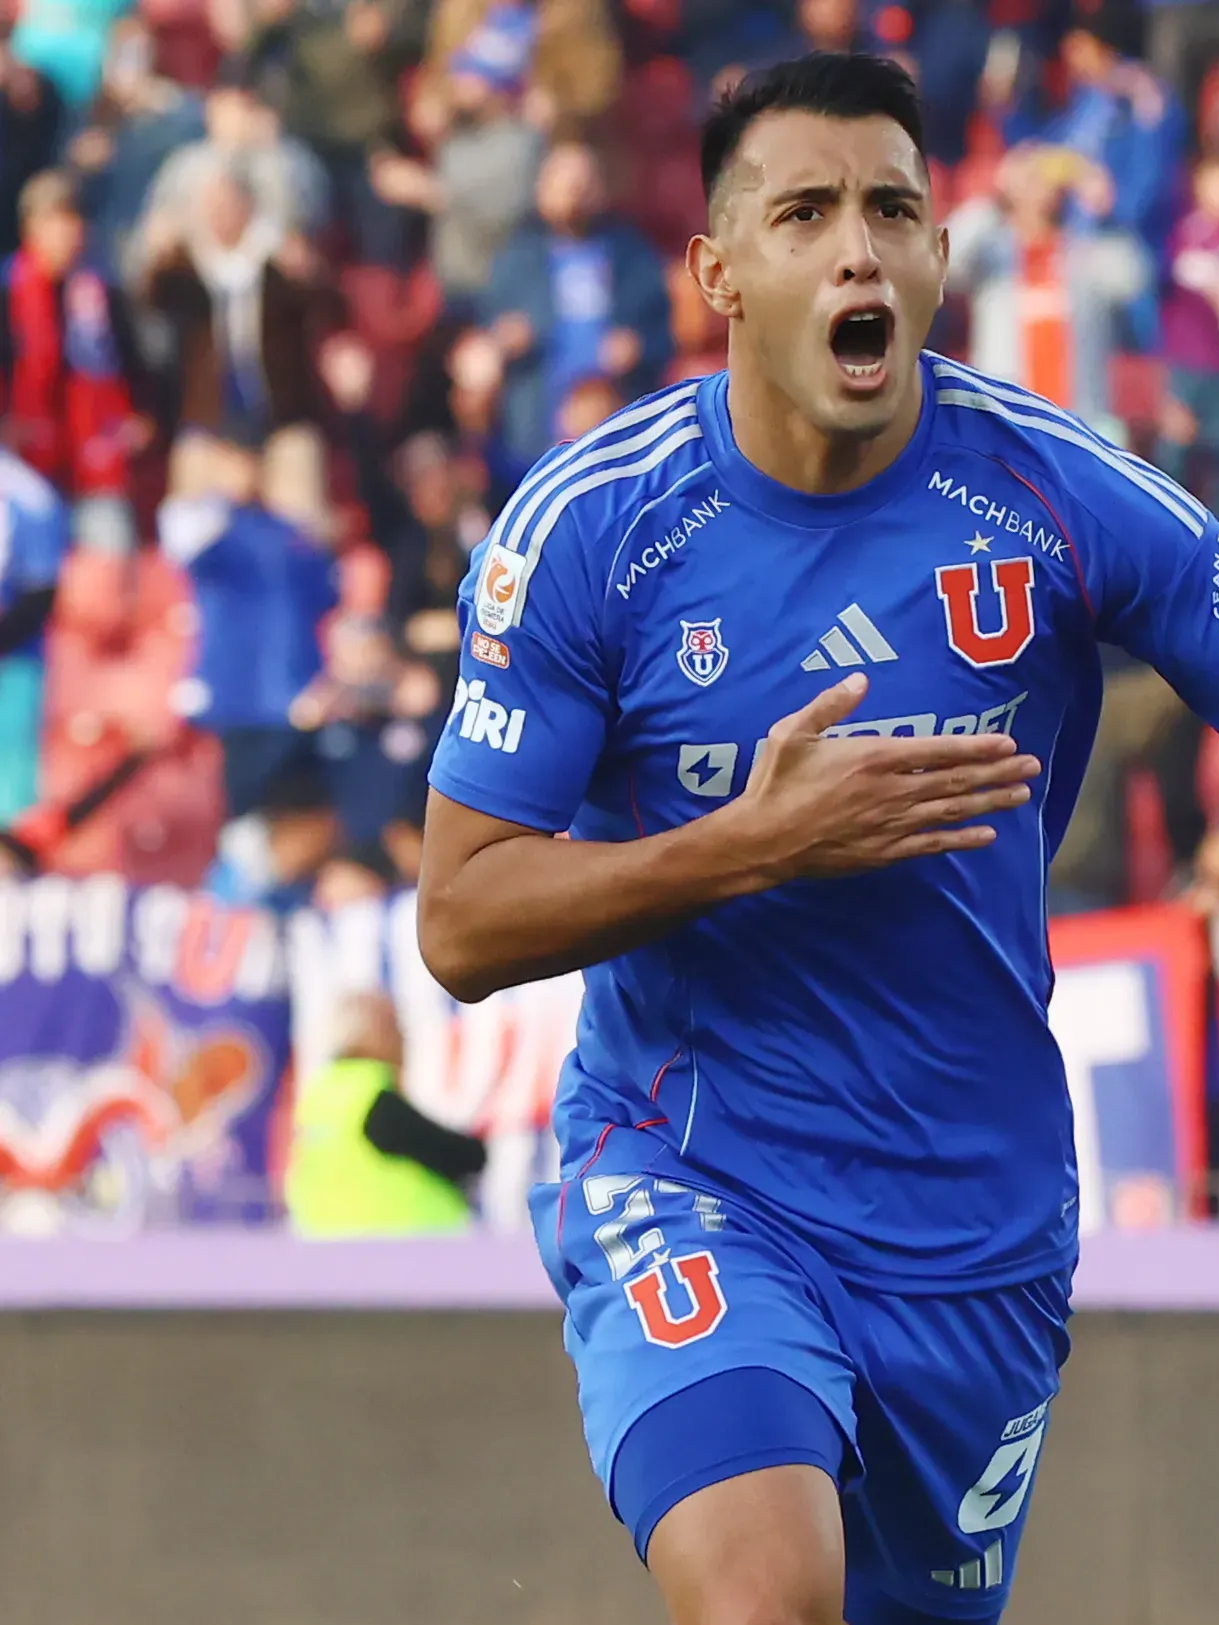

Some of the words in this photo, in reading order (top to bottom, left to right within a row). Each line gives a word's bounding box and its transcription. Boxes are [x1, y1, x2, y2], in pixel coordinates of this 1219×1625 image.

[616, 489, 730, 599] MACHBANK
[928, 471, 1071, 562] MACHBANK
[934, 556, 1035, 669] U
[692, 654, 714, 675] U
[623, 1250, 728, 1349] U
